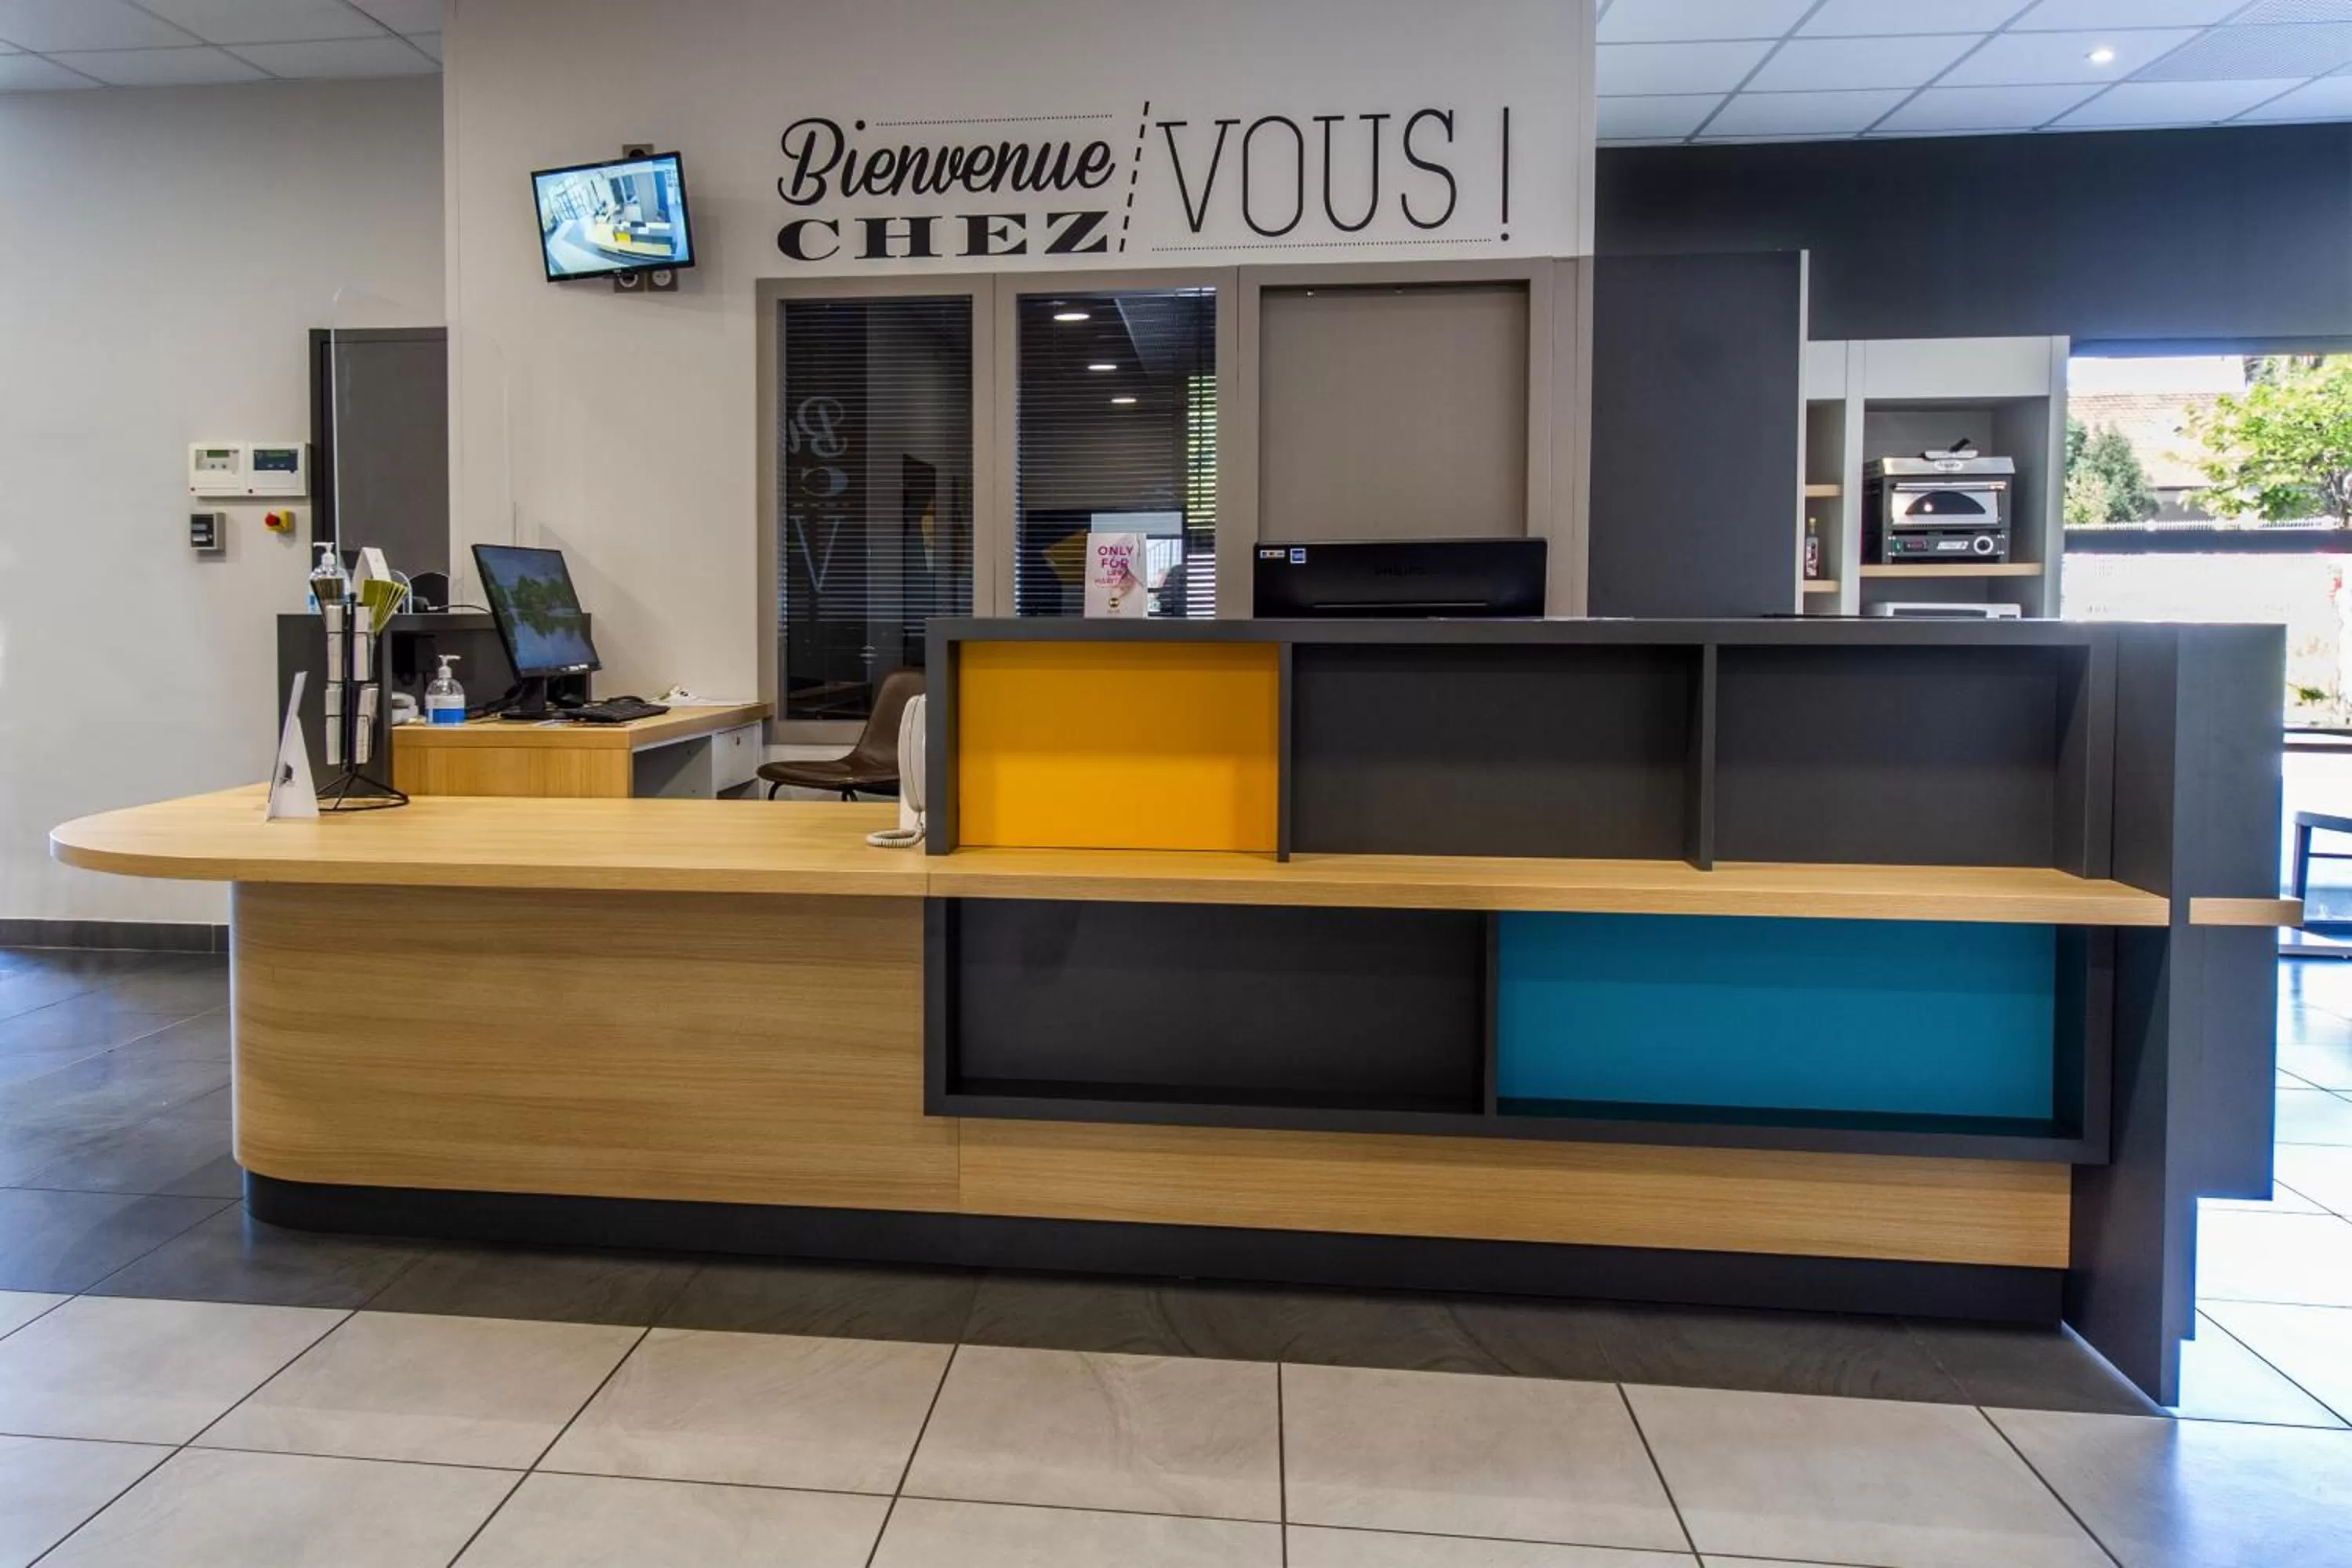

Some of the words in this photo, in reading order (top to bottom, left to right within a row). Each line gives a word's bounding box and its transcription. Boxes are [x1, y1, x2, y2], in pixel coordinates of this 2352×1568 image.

[777, 117, 1117, 207] Bienvenue
[1156, 107, 1457, 238] VOUS
[776, 210, 1109, 262] CHEZ
[1097, 545, 1134, 556] ONLY
[1101, 557, 1130, 568] FOR
